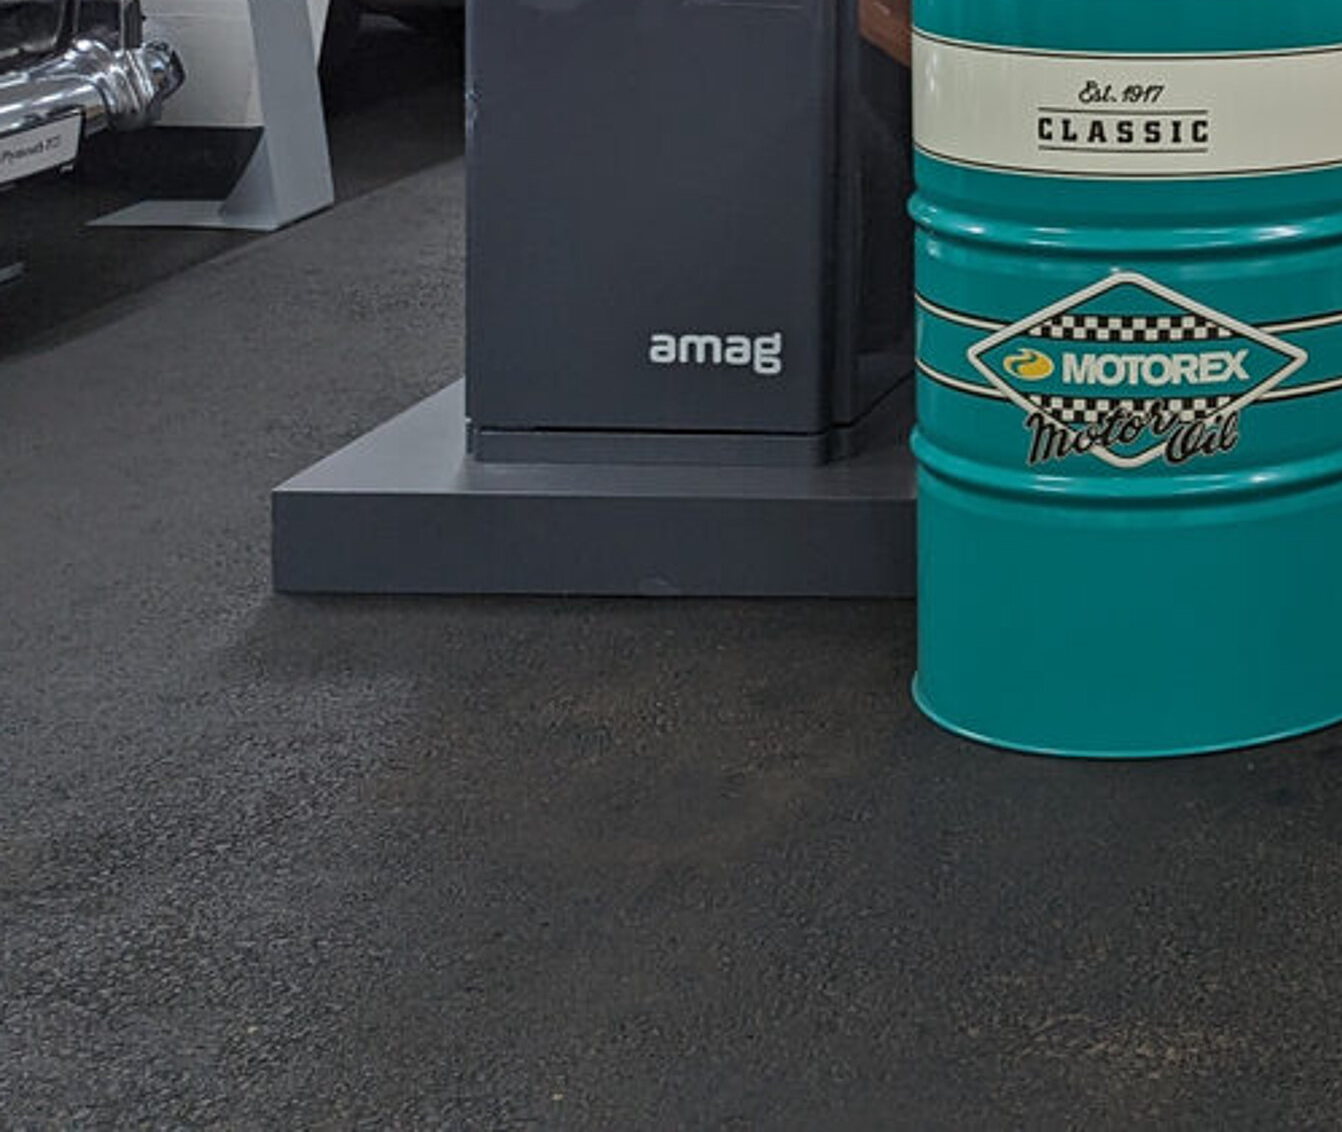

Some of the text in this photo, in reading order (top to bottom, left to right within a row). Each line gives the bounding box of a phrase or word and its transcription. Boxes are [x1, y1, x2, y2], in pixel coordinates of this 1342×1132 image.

[1078, 79, 1166, 104] Est. 1917
[1038, 116, 1209, 144] CLASSIC
[649, 331, 783, 375] amag
[1061, 349, 1251, 386] MOTOREX
[1026, 399, 1240, 465] Motor Oil
